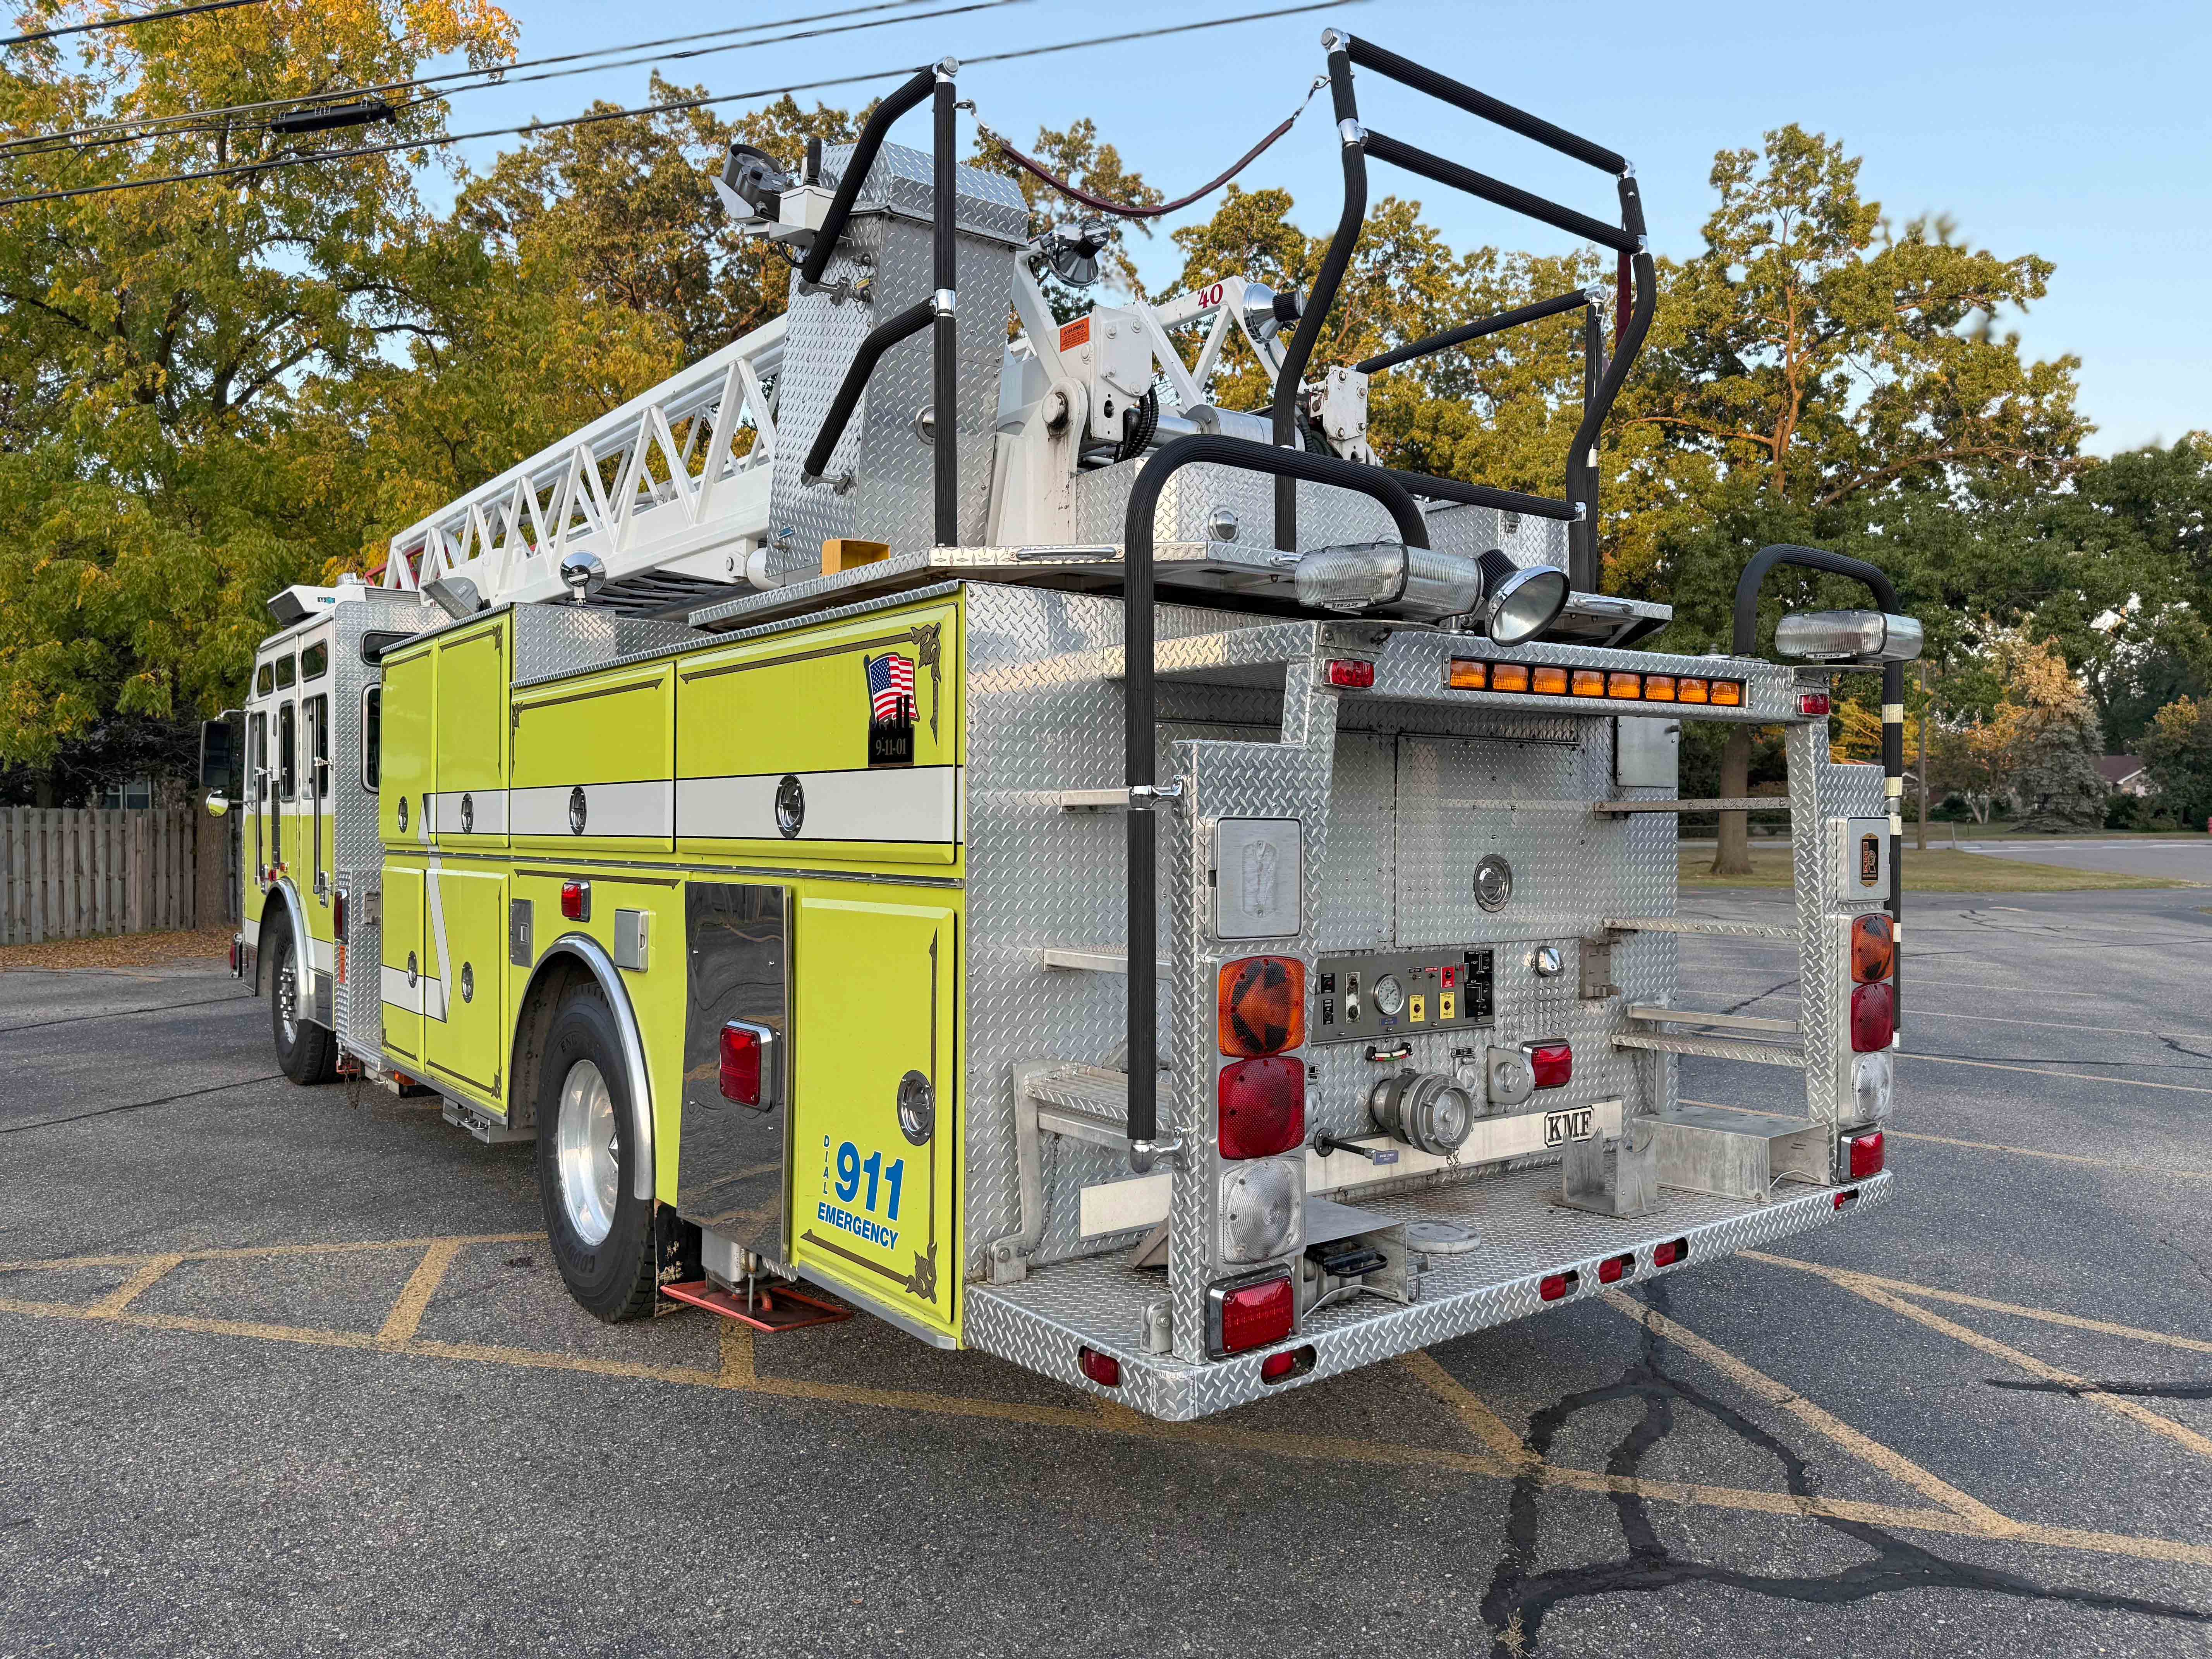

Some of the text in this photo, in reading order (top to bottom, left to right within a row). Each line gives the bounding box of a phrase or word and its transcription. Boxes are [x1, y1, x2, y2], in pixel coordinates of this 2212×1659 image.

[1198, 284, 1223, 309] 40
[1067, 323, 1084, 333] WARNING
[876, 738, 907, 756] 9-11-01
[835, 1141, 905, 1221] 911
[817, 1201, 899, 1250] EMERGENCY
